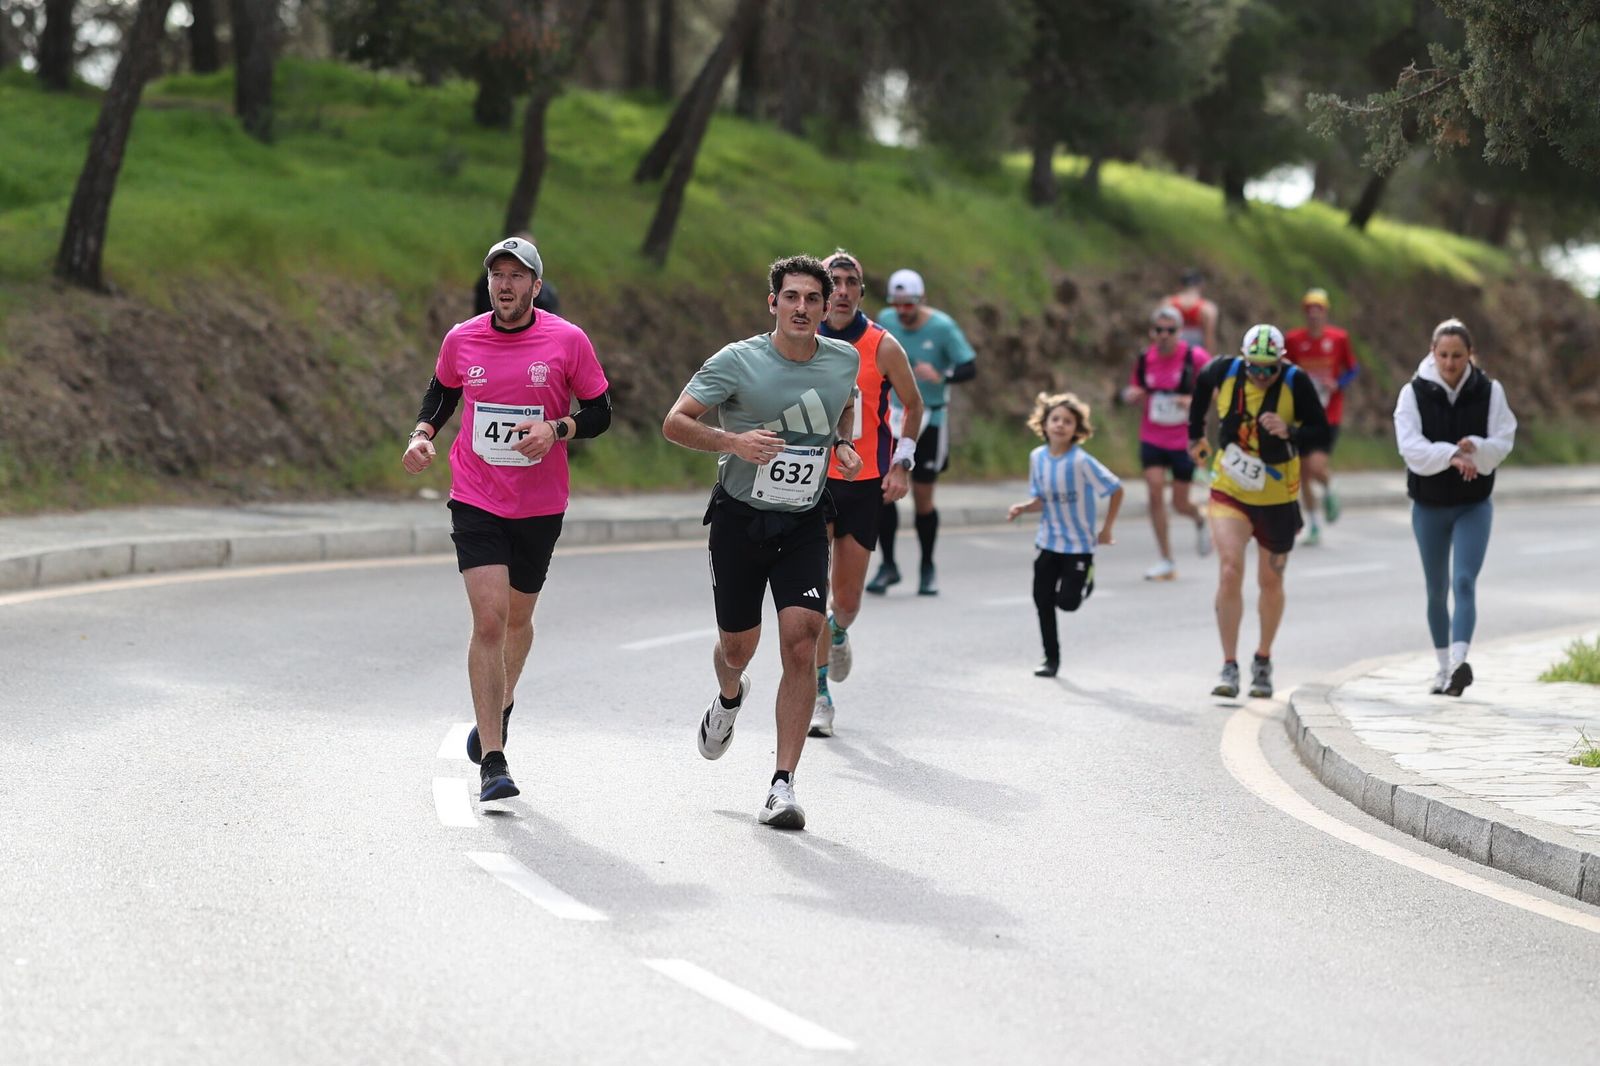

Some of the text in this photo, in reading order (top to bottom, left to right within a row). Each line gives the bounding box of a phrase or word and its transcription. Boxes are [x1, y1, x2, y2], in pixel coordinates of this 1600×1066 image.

[485, 421, 530, 443] 47
[770, 460, 814, 485] 632
[1231, 452, 1262, 480] 713
